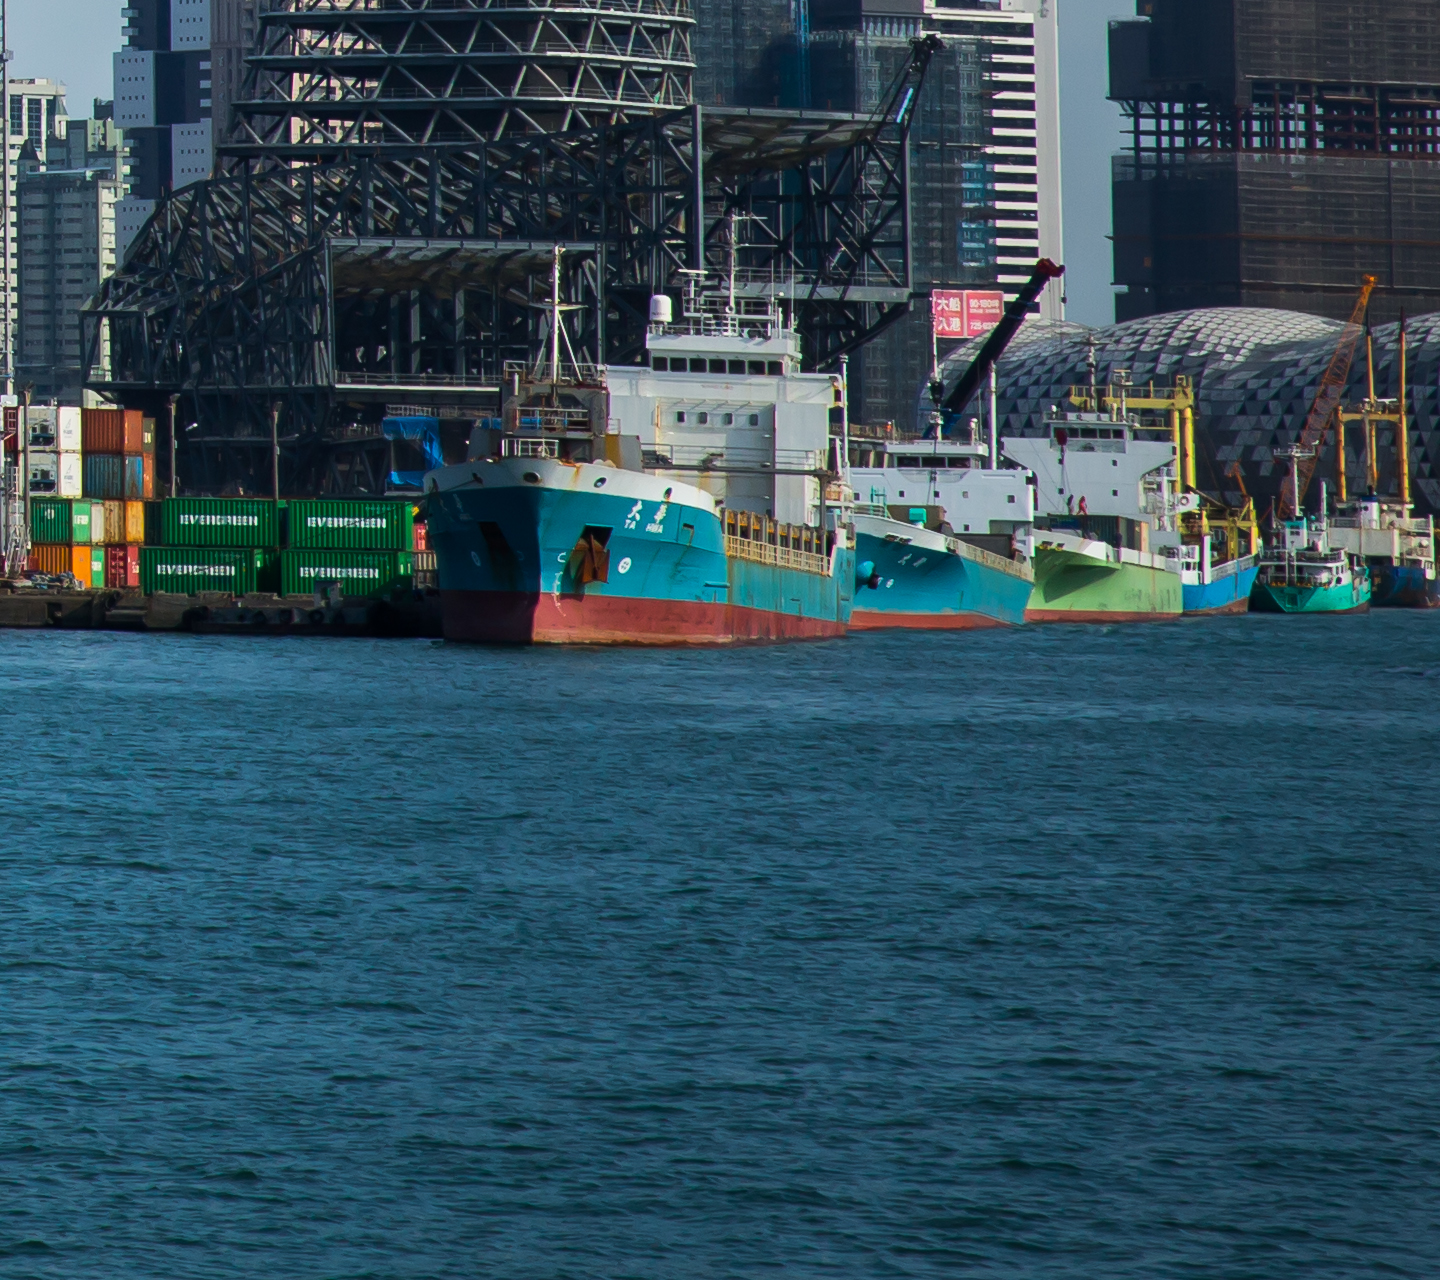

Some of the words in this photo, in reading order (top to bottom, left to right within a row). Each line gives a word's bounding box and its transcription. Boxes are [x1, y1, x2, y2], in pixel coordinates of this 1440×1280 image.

[937, 297, 961, 312] 大船
[179, 514, 259, 527] EVERGREEN
[307, 516, 387, 529] EVERGREEN
[157, 563, 236, 577] EVERGREEN
[299, 566, 379, 579] EVERGREEN
